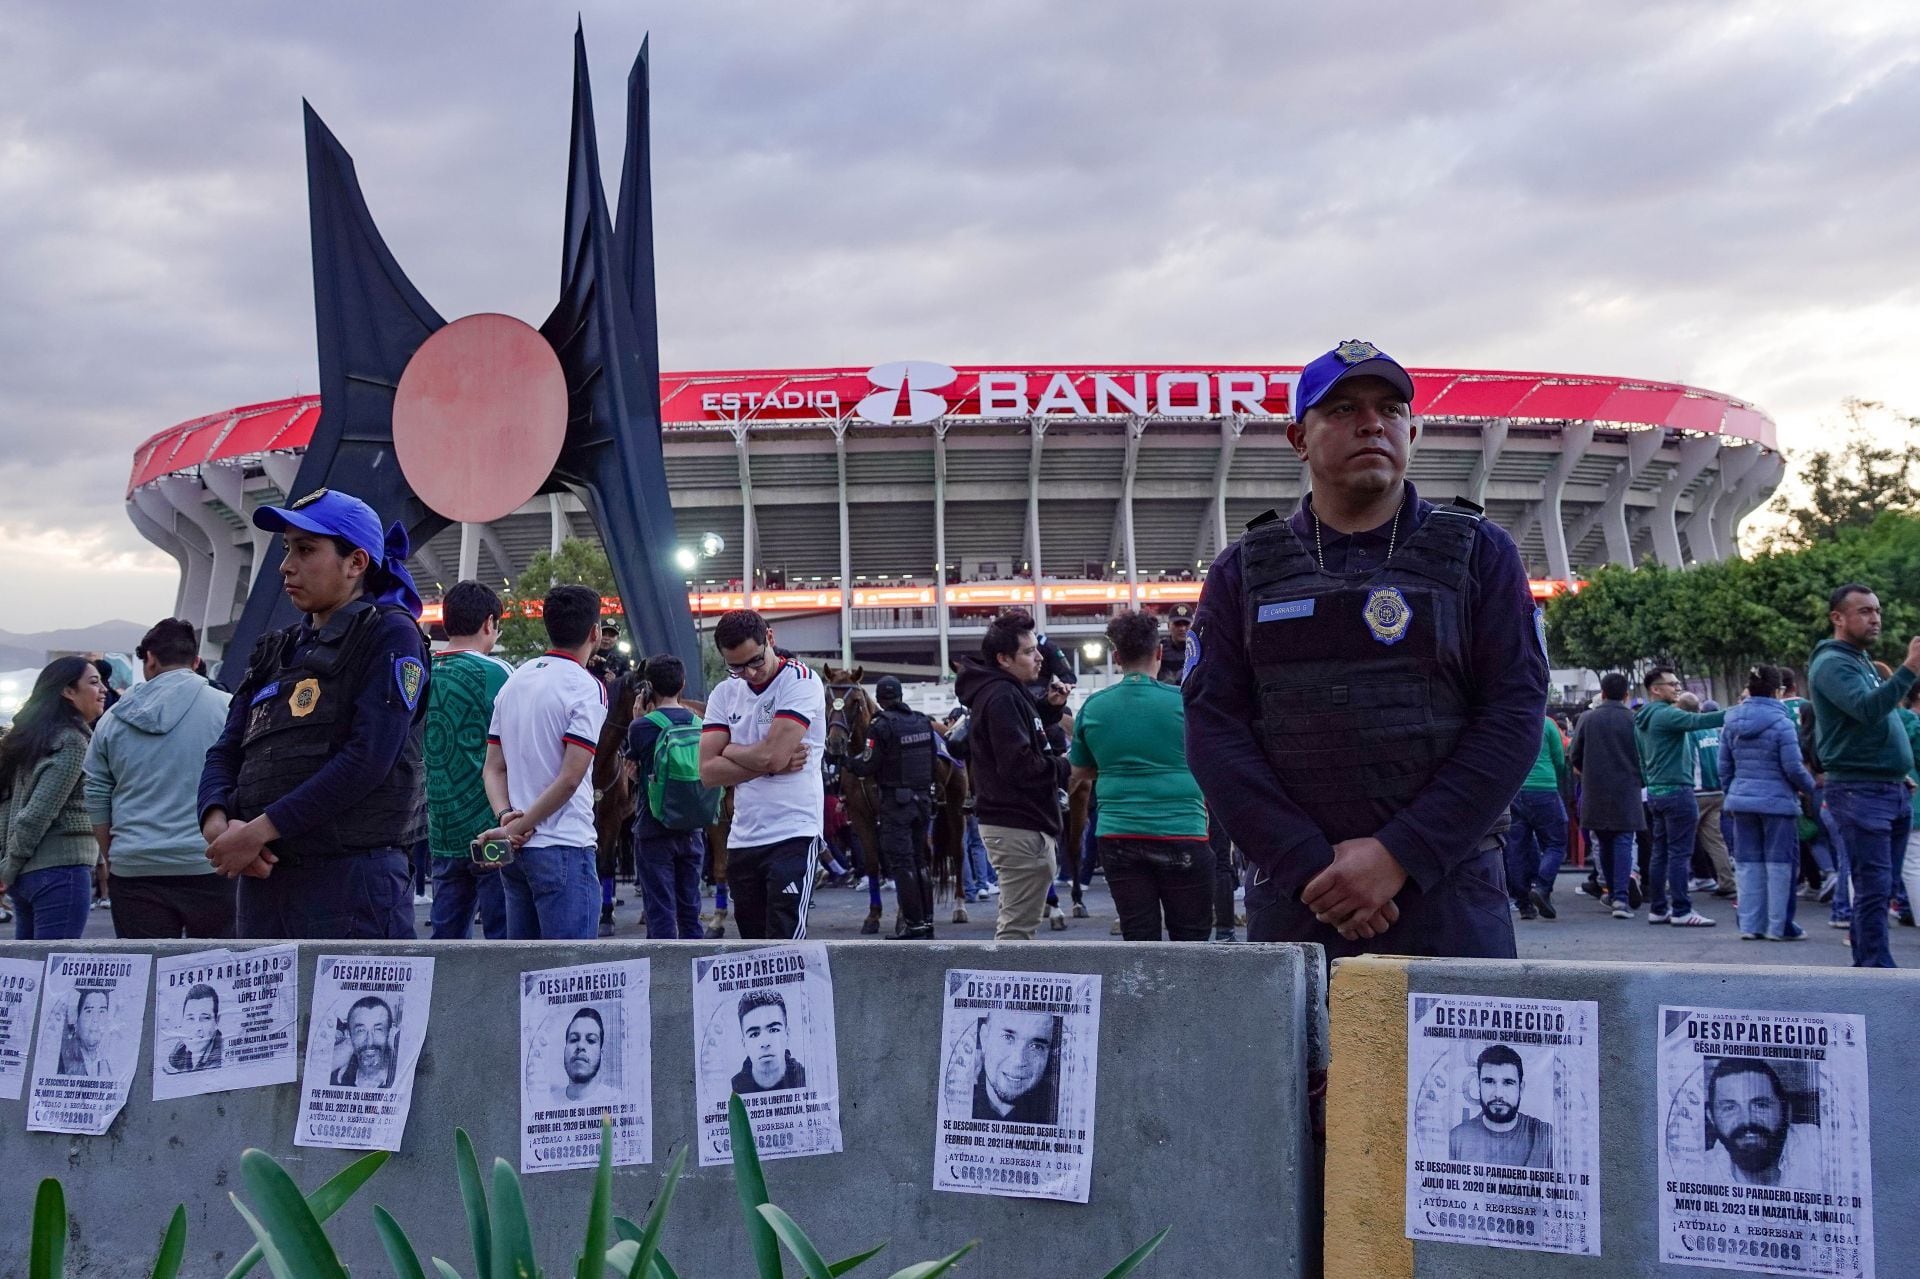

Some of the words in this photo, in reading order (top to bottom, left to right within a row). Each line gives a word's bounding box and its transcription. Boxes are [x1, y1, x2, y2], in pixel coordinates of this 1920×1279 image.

[702, 391, 839, 411] ESTADIO
[979, 373, 1298, 417] BANORT
[62, 962, 132, 977] DESAPARECIDO
[170, 957, 279, 987] DESAPARECIDO
[332, 965, 412, 981] DESAPARECIDO
[712, 955, 806, 982] DESAPARECIDO
[232, 977, 252, 990] JORGE
[359, 981, 385, 992] ARELLANO
[539, 971, 627, 995] DESAPARECIDO
[718, 980, 734, 992] SAÚL
[735, 979, 750, 990] YAEL
[751, 975, 774, 988] BUSTOS
[775, 971, 805, 985] BERUMEN
[238, 990, 256, 1004] LÓPEZ
[258, 988, 277, 1001] LÓPEZ
[548, 994, 567, 1005] PABLO
[567, 992, 589, 1003] ISMAEL
[590, 990, 603, 1000] DÍAZ
[604, 988, 622, 1000] REYES
[967, 981, 1073, 1003] DESAPARECIDO
[954, 998, 968, 1008] LUIS
[969, 998, 1003, 1010] HUMBERTO
[1005, 1000, 1046, 1012] VALDELAMAR
[1436, 1007, 1565, 1032] DESAPARECIDO
[1424, 1026, 1457, 1039] MISRAEL
[1459, 1028, 1498, 1041] ARMANDO
[1500, 1029, 1542, 1044] SEPÚLVEDA
[1688, 1020, 1828, 1046] DESAPARECIDO
[1694, 1040, 1720, 1054] CÉSAR
[1722, 1044, 1760, 1056] PORFIRIO
[1762, 1046, 1802, 1059] BERTOLDI
[1804, 1047, 1826, 1061] PÁEZ
[312, 1088, 321, 1098] FUE
[321, 1089, 345, 1100] PRIVADO
[344, 1090, 352, 1100] DE
[353, 1091, 360, 1101] SU
[716, 1101, 727, 1110] FUE
[752, 1097, 759, 1107] DE
[760, 1097, 767, 1106] SU
[768, 1093, 793, 1105] LIBERTAD
[794, 1093, 801, 1102] EL
[325, 1102, 334, 1111] DEL
[336, 1103, 349, 1113] 2021
[350, 1104, 357, 1113] EN
[357, 1104, 364, 1114] EL
[534, 1111, 544, 1121] FUE
[545, 1109, 569, 1120] PRIVADO
[569, 1108, 577, 1118] DE
[577, 1108, 585, 1117] SU
[586, 1105, 612, 1116] LIBERTAD
[704, 1113, 728, 1124] SEPTIEM
[750, 1109, 765, 1119] 2023
[766, 1108, 773, 1117] EN
[527, 1123, 551, 1135] OCTUBRE
[552, 1122, 562, 1132] DEL
[563, 1121, 578, 1131] 2020
[579, 1120, 587, 1130] EN
[943, 1120, 952, 1130] SE
[953, 1120, 990, 1133] DESCONOCE
[991, 1123, 1000, 1133] SU
[1001, 1124, 1035, 1136] PARADERO
[1036, 1126, 1058, 1138] DESDE
[944, 1134, 973, 1146] FEBRERO
[974, 1136, 986, 1147] DEL
[987, 1137, 1004, 1148] 2021
[1005, 1138, 1014, 1149] EN
[945, 1151, 985, 1164] ¡AYÚDALO
[990, 1156, 994, 1164] A
[1000, 1157, 1041, 1168] REGRESAR
[1046, 1161, 1052, 1169] A
[961, 1166, 1038, 1186] 6693262089
[1415, 1160, 1425, 1171] SE
[1427, 1161, 1471, 1176] DESCONOCE
[1473, 1165, 1484, 1177] SU
[1486, 1166, 1527, 1180] PARADERO
[1529, 1170, 1555, 1183] DESDE
[1556, 1172, 1566, 1184] EL
[1569, 1174, 1577, 1184] 17
[1580, 1174, 1590, 1186] DE
[1422, 1177, 1444, 1189] JULIO
[1446, 1179, 1460, 1190] DEL
[1462, 1181, 1484, 1193] 2020
[1486, 1182, 1496, 1194] EN
[1498, 1184, 1544, 1199] MAZATLÁN,
[1545, 1187, 1583, 1202] SINALOA.
[1666, 1180, 1677, 1193] SE
[1679, 1182, 1730, 1197] DESCONOCE
[1731, 1186, 1743, 1198] SU
[1746, 1187, 1791, 1201] PARADERO
[1793, 1192, 1822, 1205] DESDE
[1824, 1194, 1834, 1206] EL
[1838, 1195, 1849, 1207] 23
[1418, 1197, 1467, 1210] ¡AYÚDALO
[1485, 1203, 1537, 1216] REGRESAR
[1542, 1209, 1549, 1217] A
[1675, 1198, 1702, 1212] MAYO
[1704, 1201, 1720, 1213] DEL
[1722, 1202, 1746, 1216] 2023
[1748, 1205, 1760, 1217] EN
[1762, 1205, 1812, 1222] MAZATLÁN,
[1814, 1210, 1855, 1225] SINALOA.
[1439, 1211, 1535, 1237] 6693262089
[1673, 1218, 1727, 1233] ¡AYÚDALO
[1733, 1226, 1740, 1234] A
[1747, 1226, 1803, 1240] REGRESAR
[1810, 1233, 1818, 1242] A
[1824, 1233, 1859, 1246] CASA!
[1696, 1235, 1801, 1261] 6693262089
